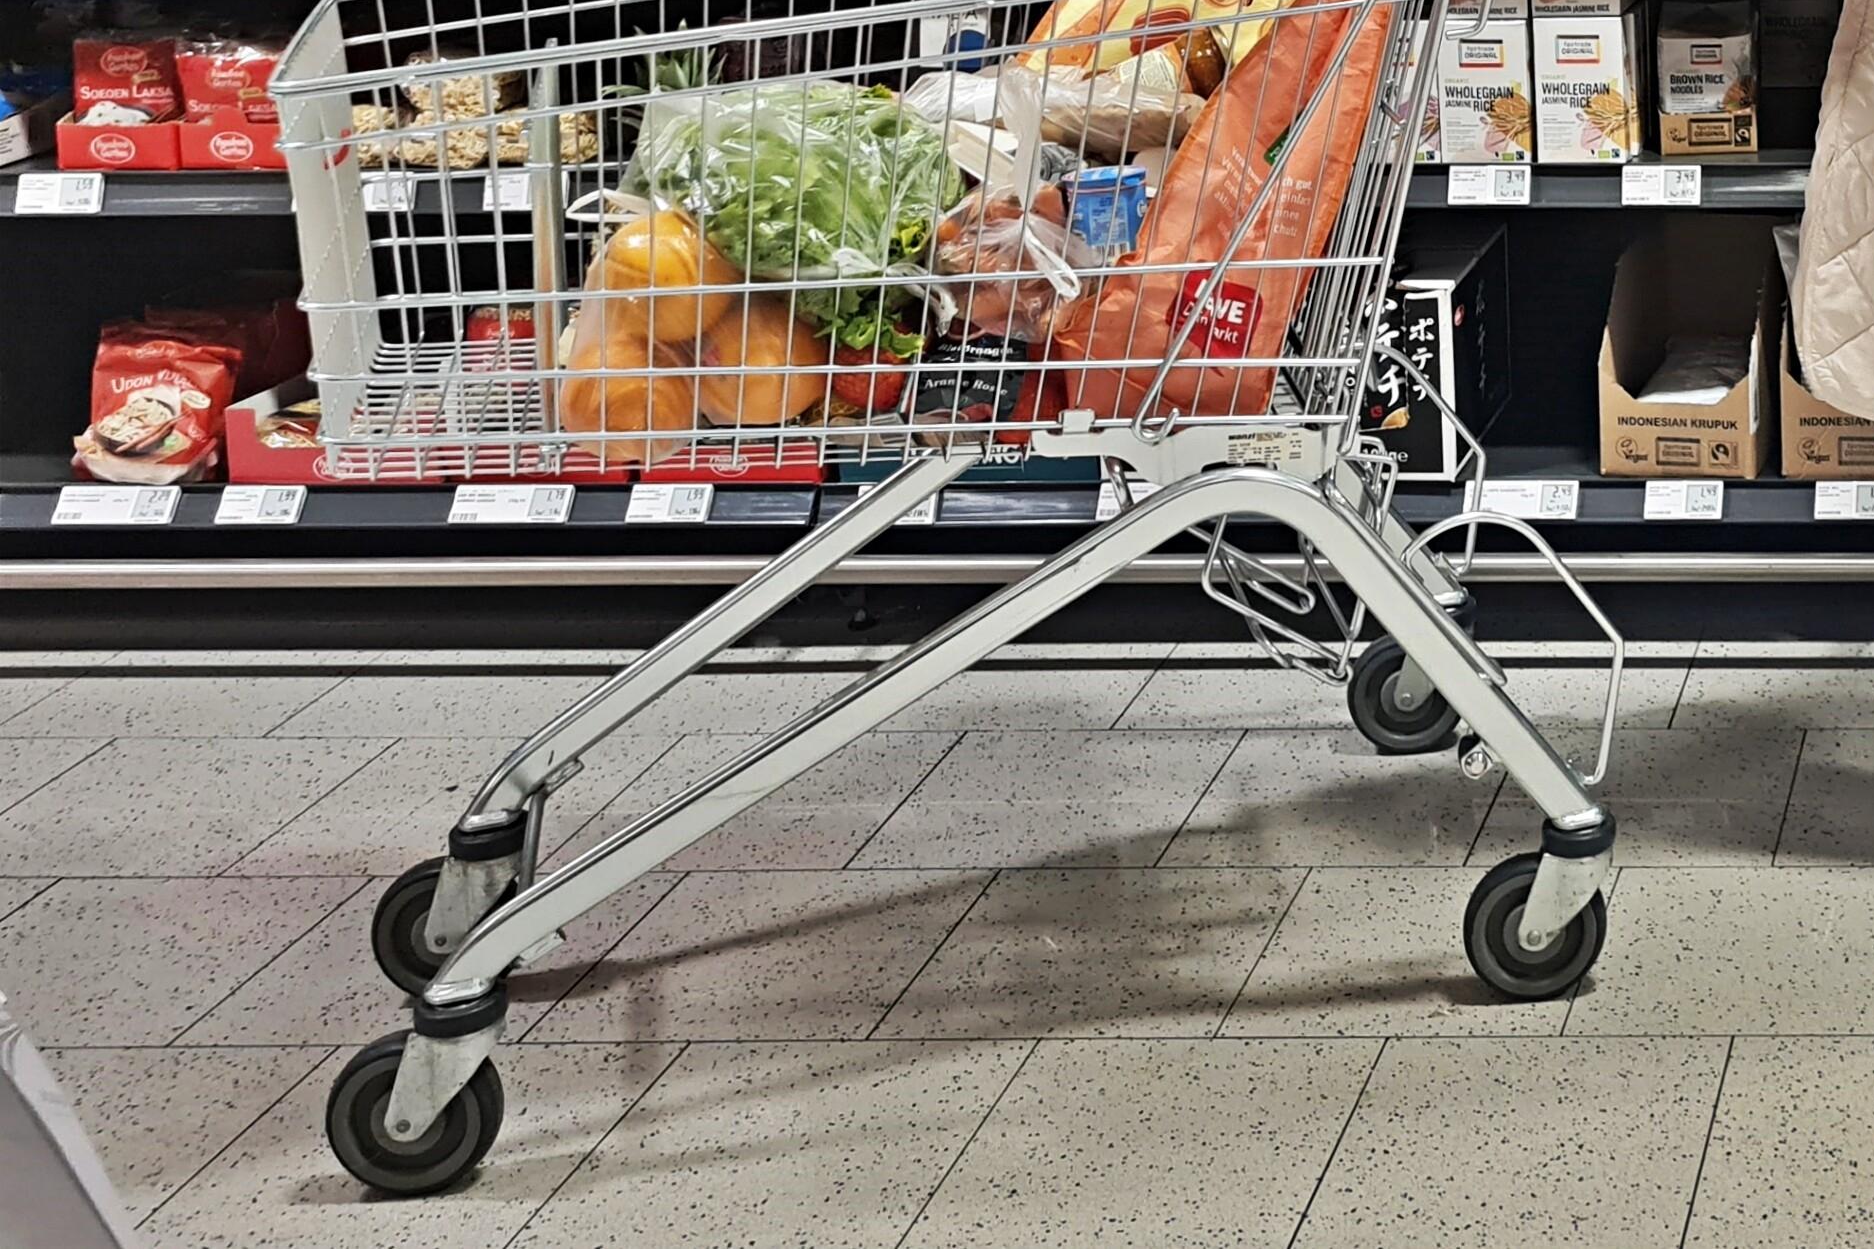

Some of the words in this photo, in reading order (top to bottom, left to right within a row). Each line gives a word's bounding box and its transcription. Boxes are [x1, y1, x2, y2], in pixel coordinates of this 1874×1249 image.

[1597, 4, 1610, 12] RICE
[1464, 51, 1498, 59] ORIGINAL
[1670, 74, 1703, 84] BROWN
[1705, 74, 1724, 84] RICE
[132, 87, 174, 97] LAKSA
[1445, 85, 1514, 100] WHOLEGRAIN
[1541, 82, 1610, 95] WHOLEGRAIN
[1670, 85, 1703, 95] NOODLES
[1445, 100, 1472, 108] JASMINE
[1473, 100, 1496, 113] RICE
[1541, 96, 1569, 105] JASMINE
[1569, 97, 1592, 109] RICE
[111, 375, 154, 394] UDON
[1617, 416, 1688, 428] INDONESIAN
[1690, 419, 1738, 430] KRUPUK
[1800, 417, 1871, 427] INDONESIAN
